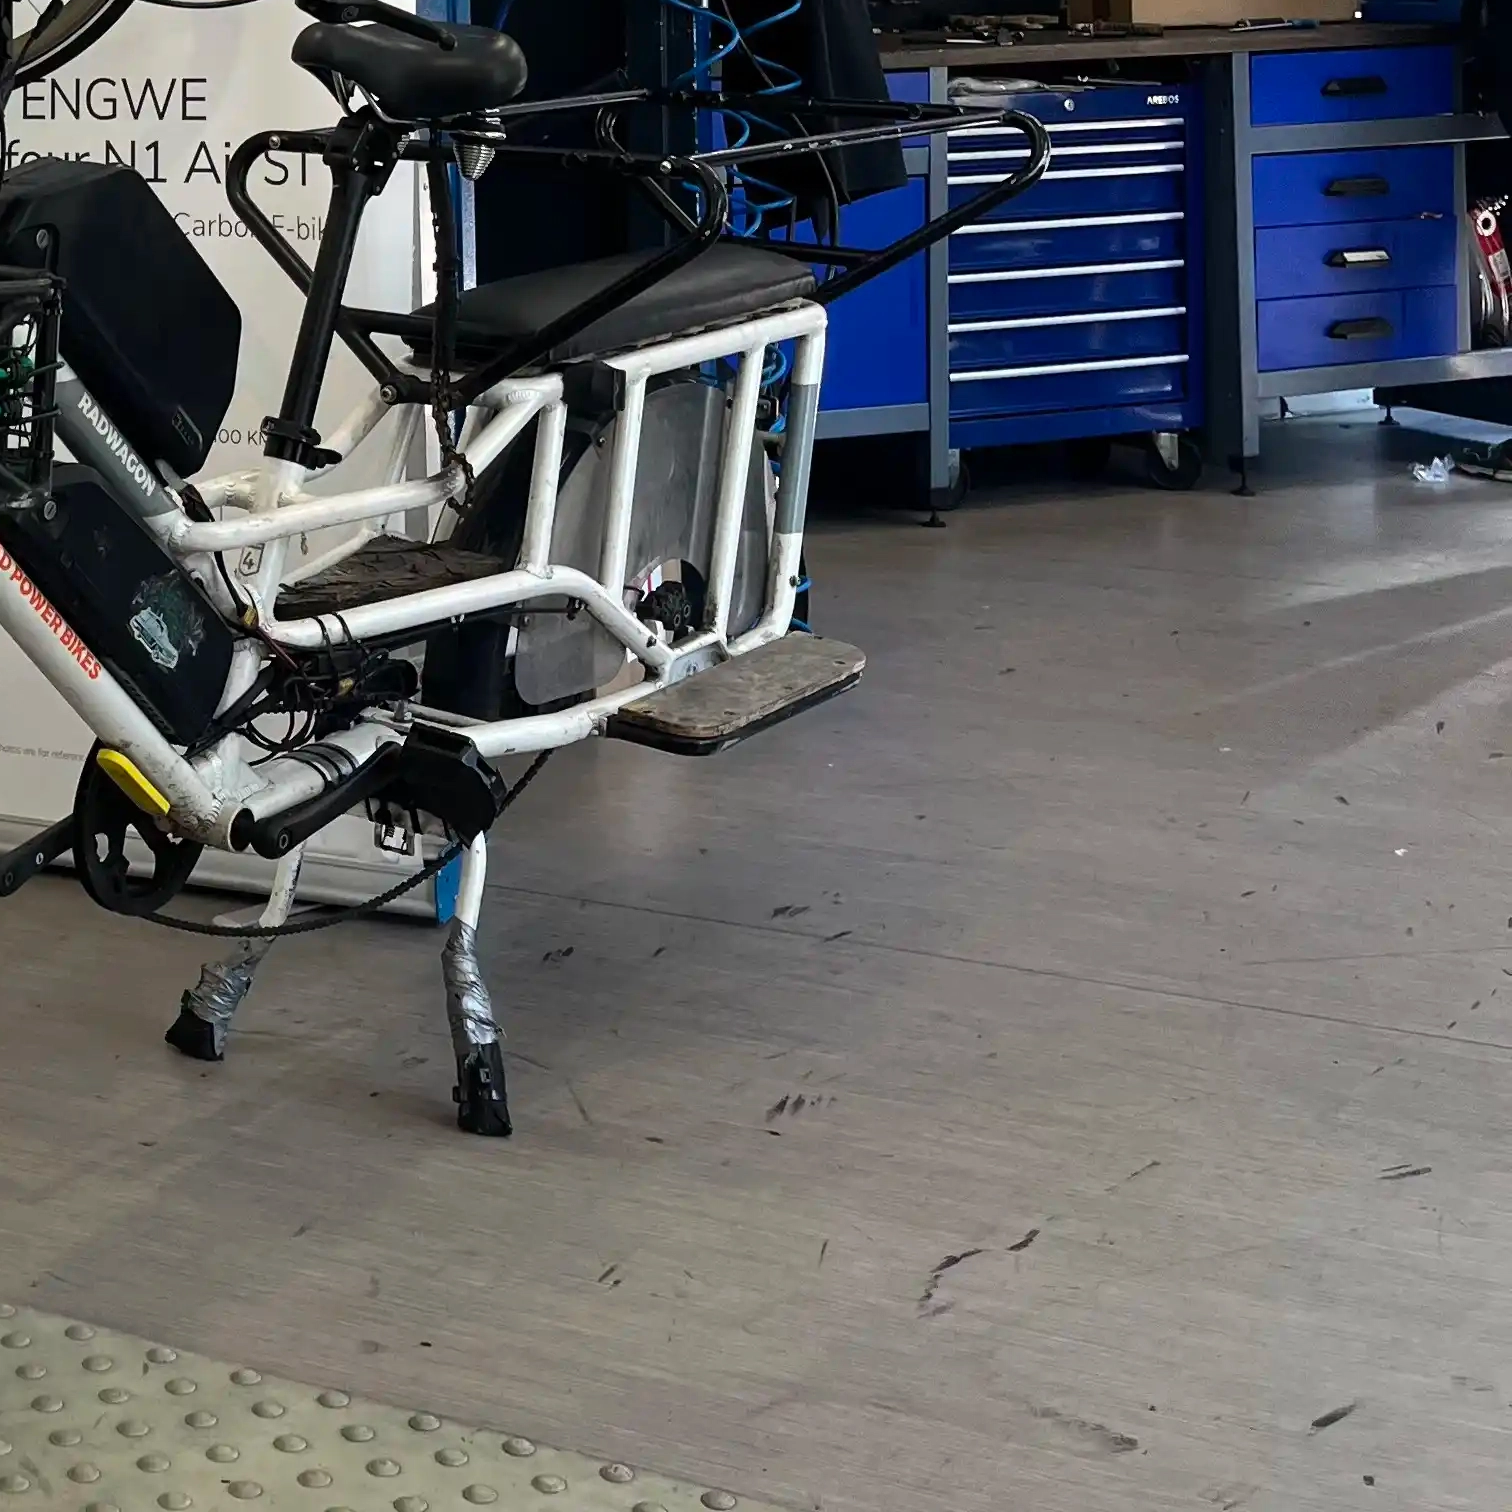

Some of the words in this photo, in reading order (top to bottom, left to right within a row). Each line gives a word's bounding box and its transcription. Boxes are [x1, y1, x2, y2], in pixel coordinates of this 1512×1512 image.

[21, 78, 208, 121] ENGWE
[174, 212, 255, 239] Carbo
[77, 391, 156, 497] RADWAGON
[10, 565, 63, 634] POWER
[59, 625, 102, 680] BIKES
[23, 747, 36, 757] are
[38, 747, 50, 758] for
